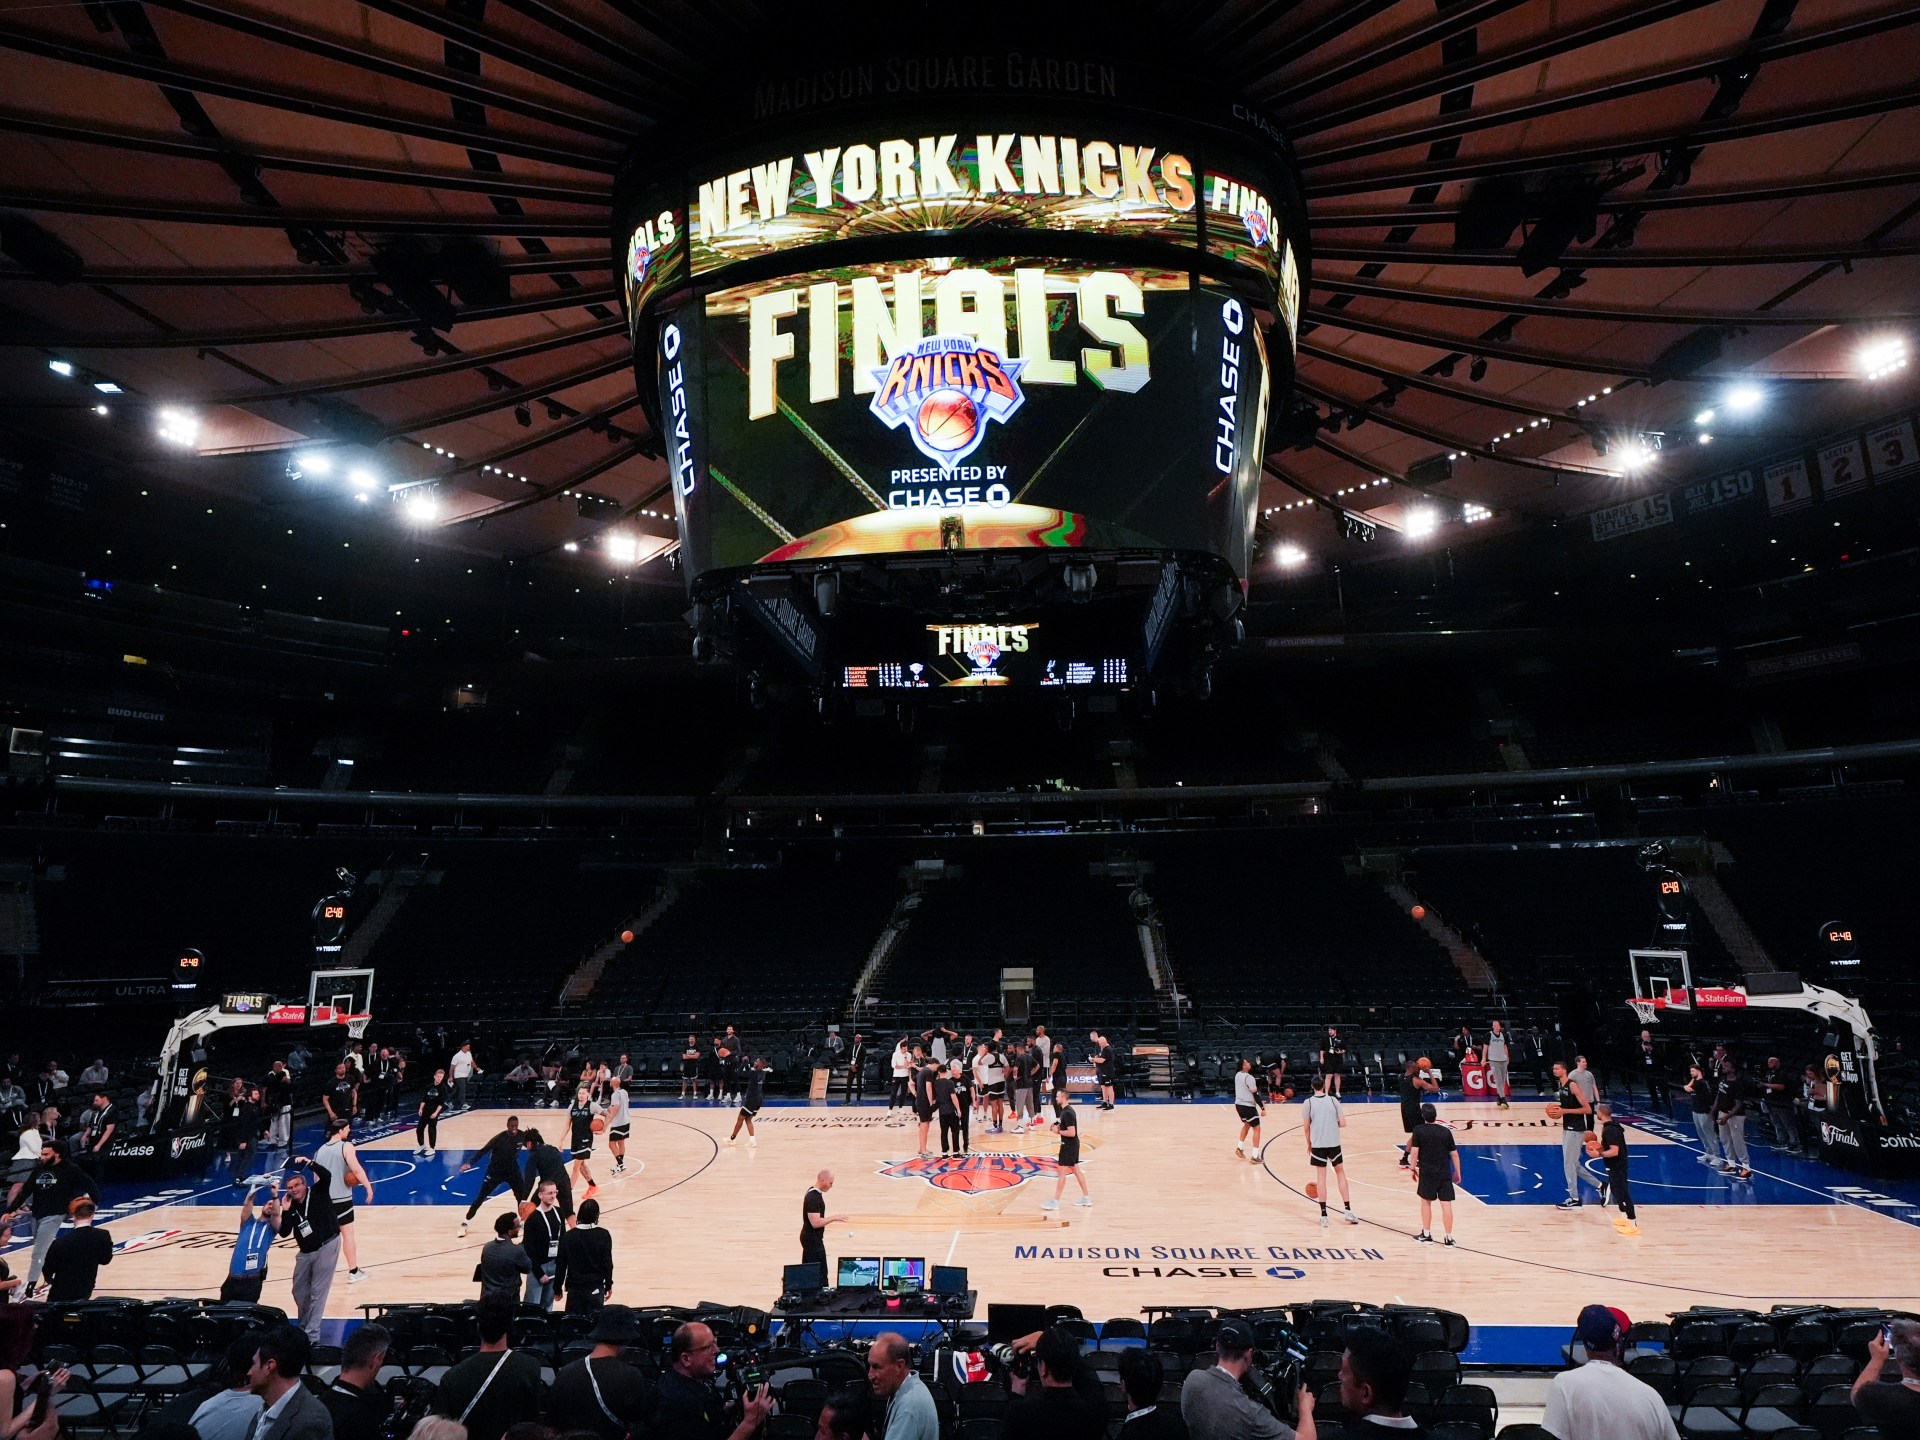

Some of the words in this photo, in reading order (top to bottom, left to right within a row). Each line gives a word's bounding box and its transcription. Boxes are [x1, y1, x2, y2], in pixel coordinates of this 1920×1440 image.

[754, 65, 874, 118] MADISON
[885, 54, 994, 92] SQUARE
[1007, 51, 1115, 97] GARDEN
[699, 157, 793, 241] NEW
[804, 134, 964, 208] YORK
[976, 133, 1196, 212] KNICKS
[749, 268, 1151, 421] FINALS
[917, 340, 941, 354] NEW
[943, 339, 972, 351] YORK
[877, 349, 1016, 407] KNICKS
[1215, 336, 1241, 474] CHASE
[668, 361, 695, 496] CHASE
[1882, 439, 1905, 467] 3
[891, 466, 982, 484] PRESENTED
[986, 465, 1007, 480] BY
[1831, 456, 1852, 485] 2
[1711, 470, 1754, 503] 150
[1780, 475, 1796, 501] 1
[888, 486, 981, 510] CHASE
[1596, 504, 1633, 522] HARRY
[1643, 493, 1669, 521] 15
[1595, 514, 1639, 534] STYLES
[939, 626, 1029, 655] FINALS
[107, 706, 132, 717] BUD
[132, 710, 166, 721] LIGHT
[1661, 881, 1680, 893] 12:48
[325, 906, 343, 918] 12:48
[1829, 931, 1852, 941] 12:48
[180, 958, 199, 967] 12:48
[116, 985, 167, 997] ULTRA
[1705, 994, 1743, 1003] StateFarm
[226, 995, 263, 1009] FINALS
[281, 1011, 305, 1021] StateFa
[1841, 1052, 1852, 1061] GET
[179, 1068, 189, 1077] GET
[1842, 1062, 1854, 1071] THE
[178, 1077, 187, 1086] THE
[1066, 1075, 1091, 1084] HASE
[1466, 1070, 1484, 1089] G
[1847, 1072, 1858, 1083] App
[179, 1086, 188, 1097] App
[1827, 1125, 1859, 1147] Finals
[1014, 1245, 1140, 1260] MADISON
[1151, 1245, 1262, 1261] SQUARE
[1266, 1245, 1384, 1261] GARDEN
[1102, 1267, 1257, 1279] CHASE
